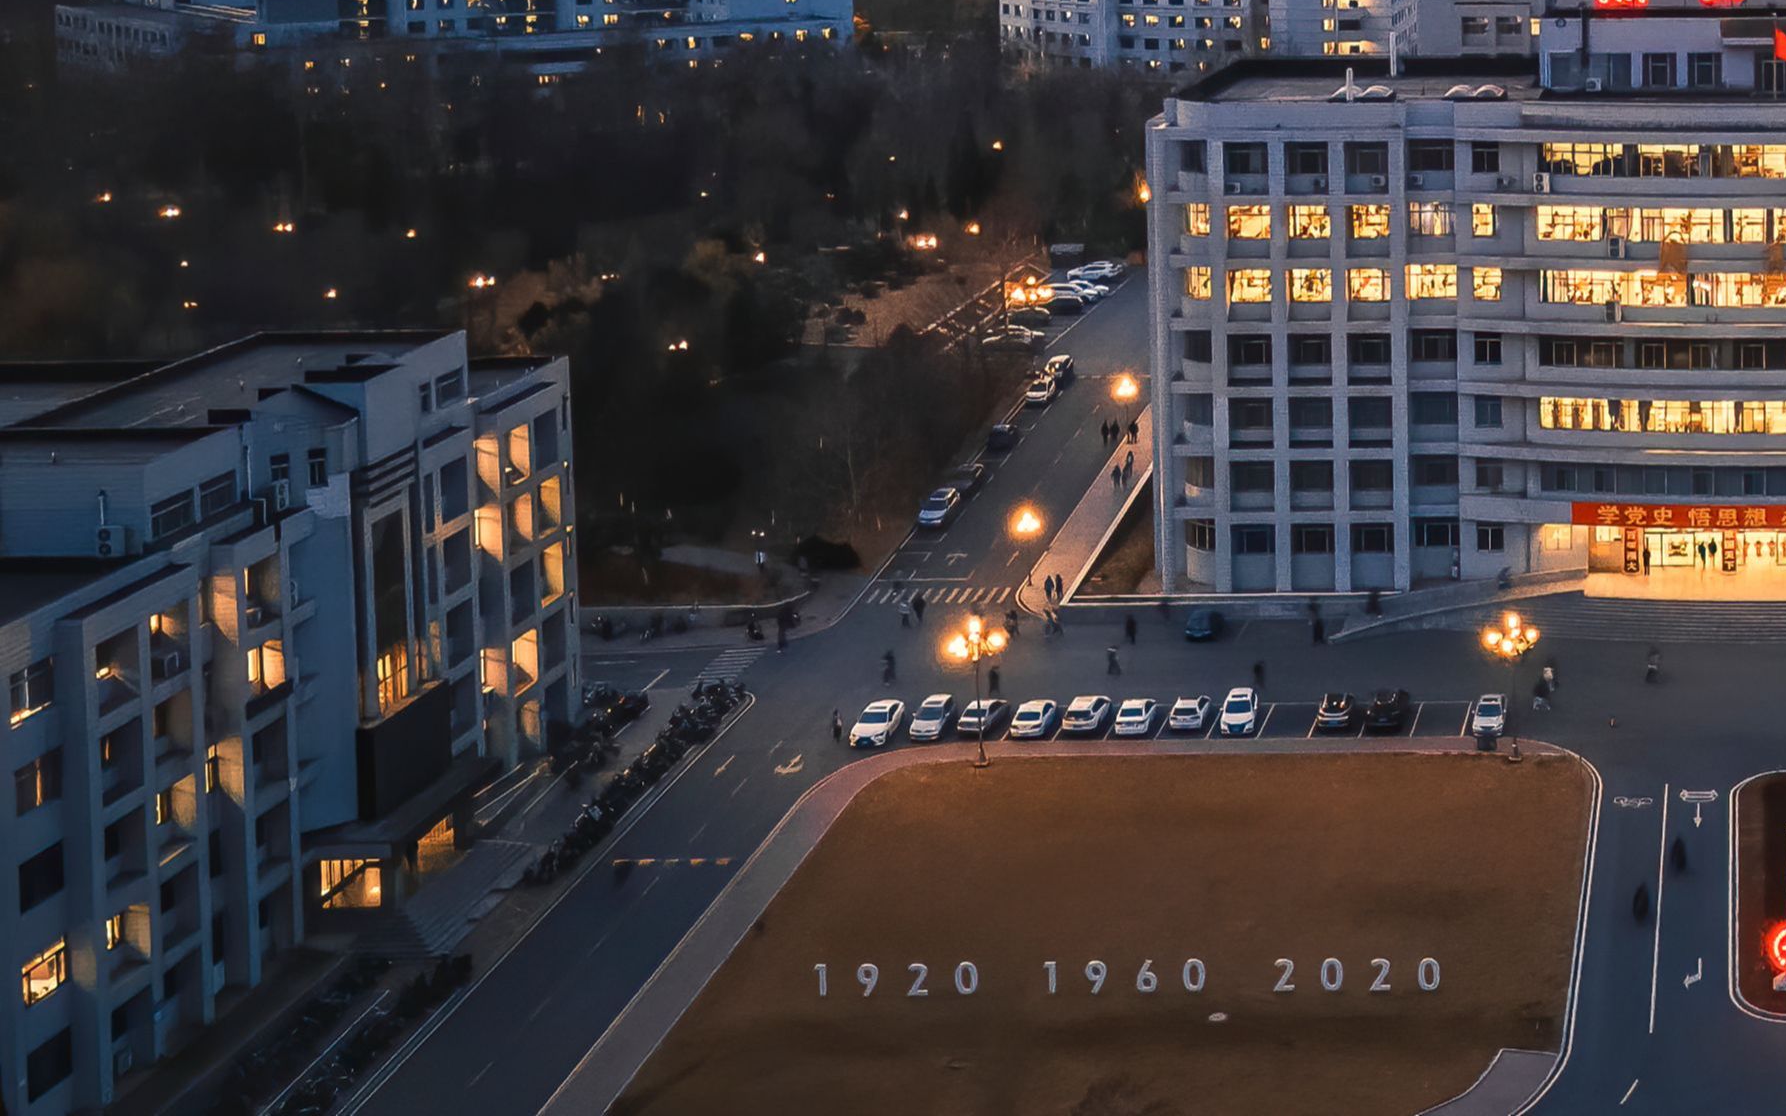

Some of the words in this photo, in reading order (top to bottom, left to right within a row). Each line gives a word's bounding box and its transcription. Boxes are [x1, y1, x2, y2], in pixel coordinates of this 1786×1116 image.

[1597, 505, 1674, 525] 学党史
[1688, 507, 1767, 527] 悟思想
[814, 962, 979, 997] 1920
[1043, 958, 1206, 994] 1960
[1273, 957, 1440, 992] 2020
